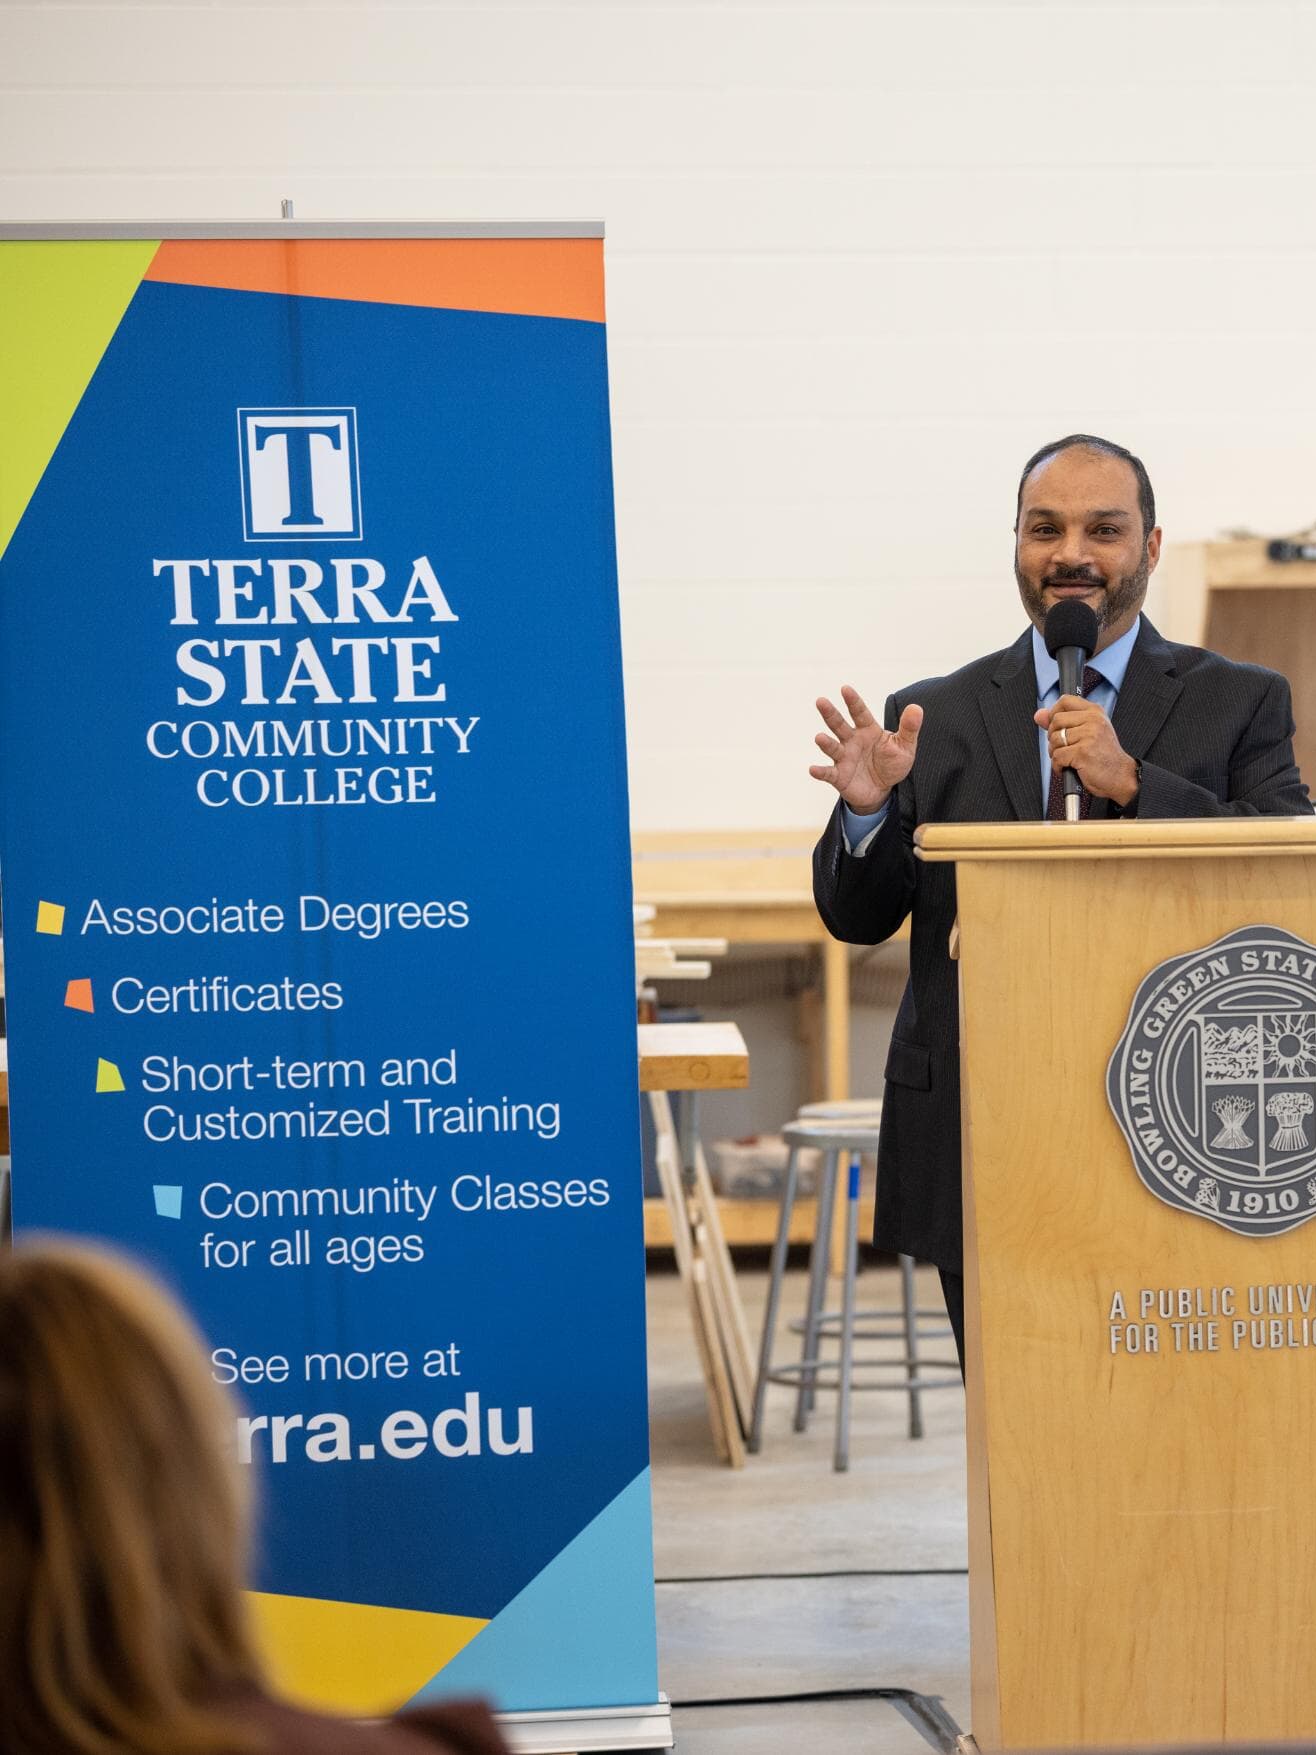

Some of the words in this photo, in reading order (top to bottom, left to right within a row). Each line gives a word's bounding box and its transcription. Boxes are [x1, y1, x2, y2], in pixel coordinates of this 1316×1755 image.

[255, 423, 342, 526] T
[153, 556, 459, 624] TERRA
[177, 636, 446, 706] STATE
[147, 717, 480, 758] COMMUNITY
[197, 767, 436, 806] COLLEGE
[81, 898, 284, 934] Associate
[300, 896, 469, 939] Degrees
[112, 976, 343, 1013] Certificates
[1143, 956, 1229, 1039] GREEN
[143, 1056, 365, 1092] Short-term
[381, 1049, 456, 1086] and
[144, 1100, 389, 1141] Customized
[403, 1096, 560, 1138] Training
[1130, 1048, 1197, 1189] BOWLING
[200, 1179, 437, 1221] Community
[452, 1175, 609, 1211] Classes
[1226, 1189, 1299, 1214] 1910
[200, 1233, 255, 1267] for
[270, 1230, 309, 1266] all
[326, 1235, 424, 1272] ages
[1109, 1290, 1128, 1320] A
[1140, 1286, 1236, 1319] PUBLIC
[1110, 1323, 1159, 1354] FOR
[1171, 1321, 1220, 1352] THE
[211, 1348, 290, 1385] See
[304, 1352, 409, 1382] more
[422, 1342, 462, 1378] at
[236, 1391, 534, 1465] rra.edu
